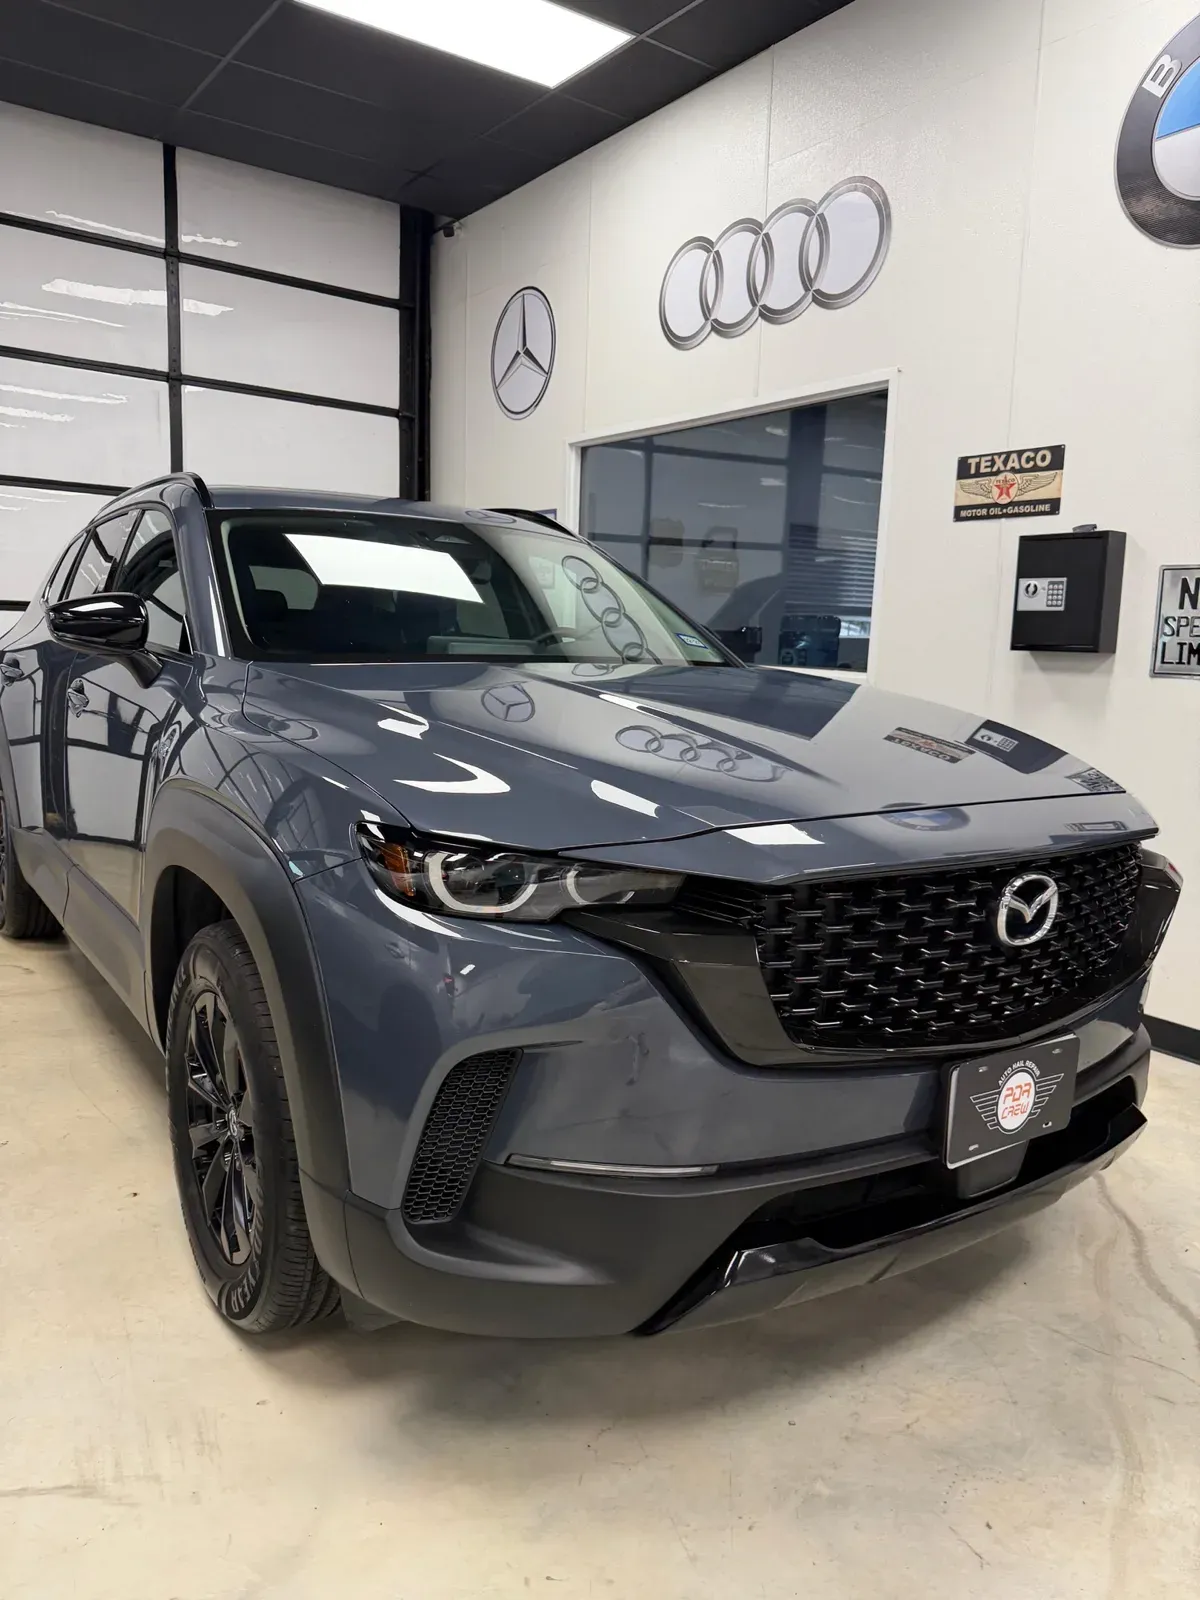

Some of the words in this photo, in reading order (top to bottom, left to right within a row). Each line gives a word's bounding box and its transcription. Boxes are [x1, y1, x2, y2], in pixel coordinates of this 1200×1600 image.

[967, 449, 1052, 475] TEXACO
[960, 508, 987, 518] MOTOR
[989, 507, 1003, 516] OIL
[1006, 504, 1051, 514] GASOLINE
[998, 1066, 1012, 1086] AUTO
[1012, 1060, 1025, 1069] HAIL
[1025, 1059, 1041, 1077] REPAIR
[1002, 1082, 1032, 1105] PDR
[1000, 1101, 1030, 1120] CREW
